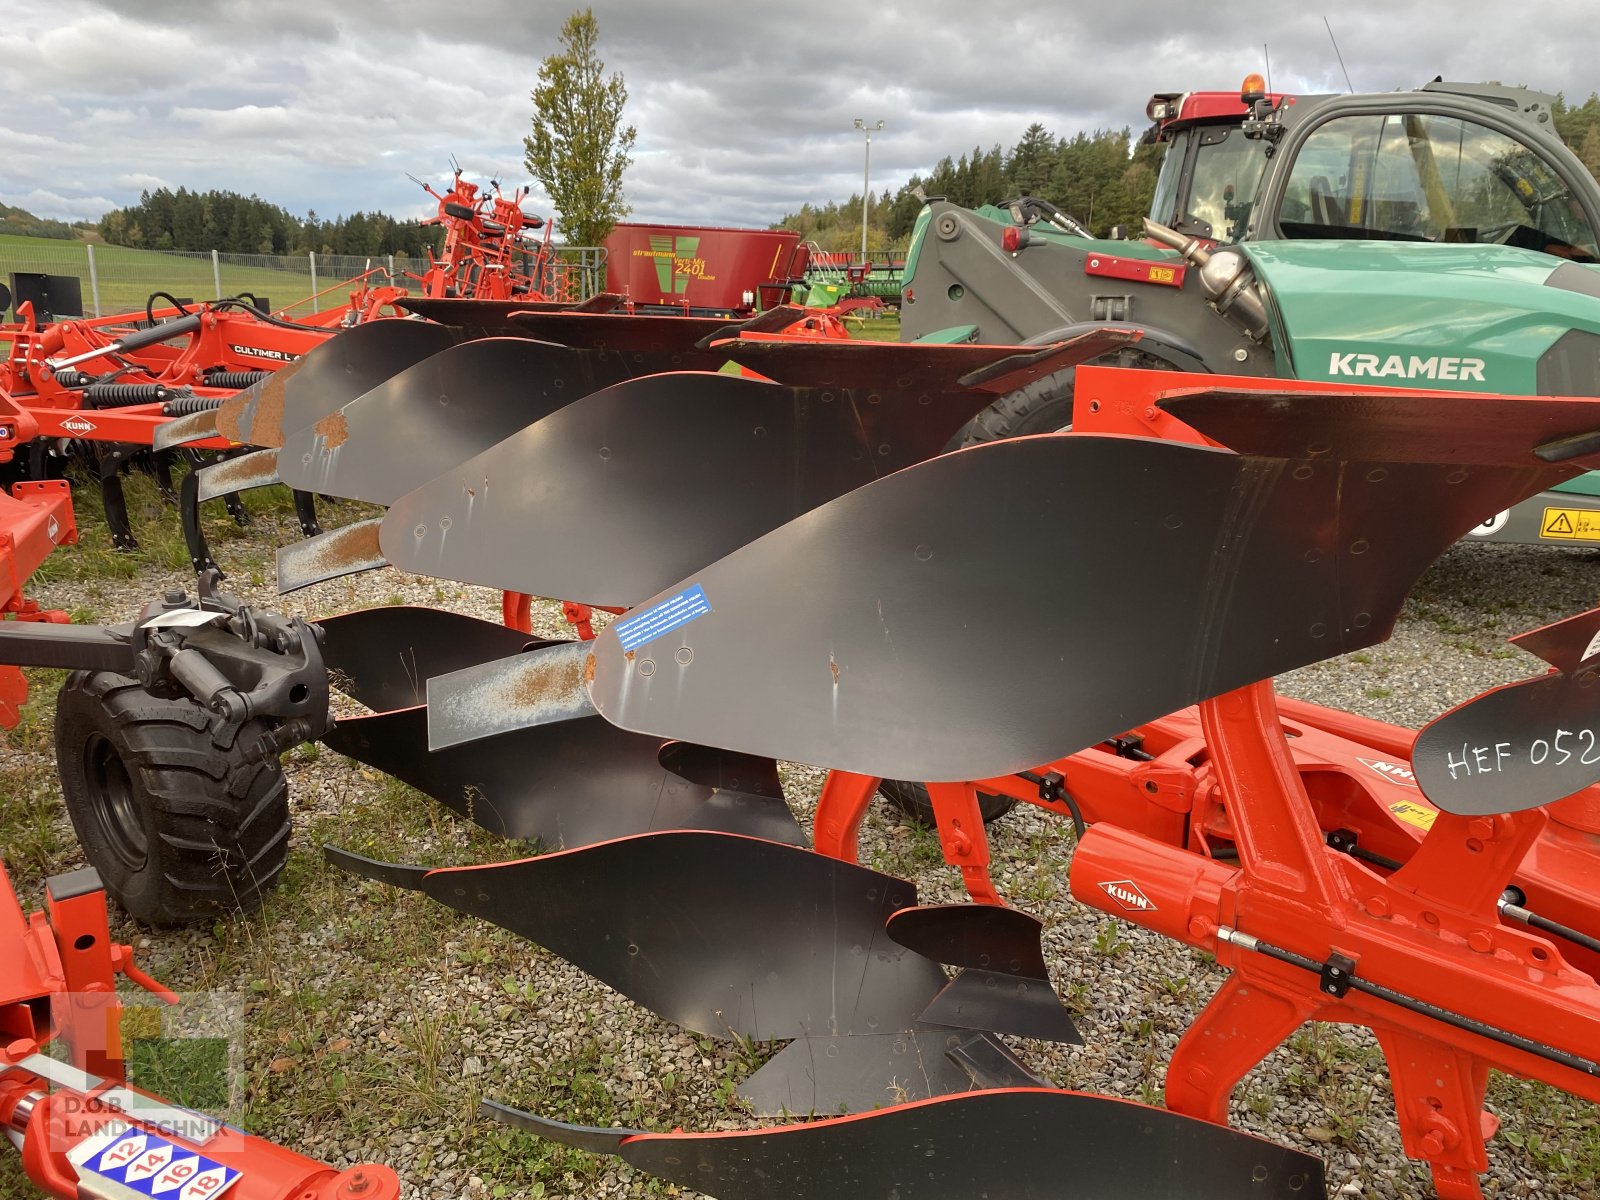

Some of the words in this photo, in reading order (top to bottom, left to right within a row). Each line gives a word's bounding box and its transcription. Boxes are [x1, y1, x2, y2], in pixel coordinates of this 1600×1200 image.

[633, 249, 676, 258] strautmann
[674, 257, 706, 266] Verti-Mix
[675, 263, 705, 275] 2401
[234, 345, 282, 359] CULTIMER
[1328, 352, 1486, 381] KRAMER
[66, 421, 91, 430] KUHN
[1447, 742, 1511, 780] HEF
[1531, 729, 1600, 765] 052
[1372, 761, 1416, 781] HN
[1107, 883, 1148, 909] KUHN
[108, 1142, 141, 1162] 12
[134, 1153, 165, 1174] 14
[161, 1164, 193, 1185] 16
[188, 1176, 220, 1196] 18
